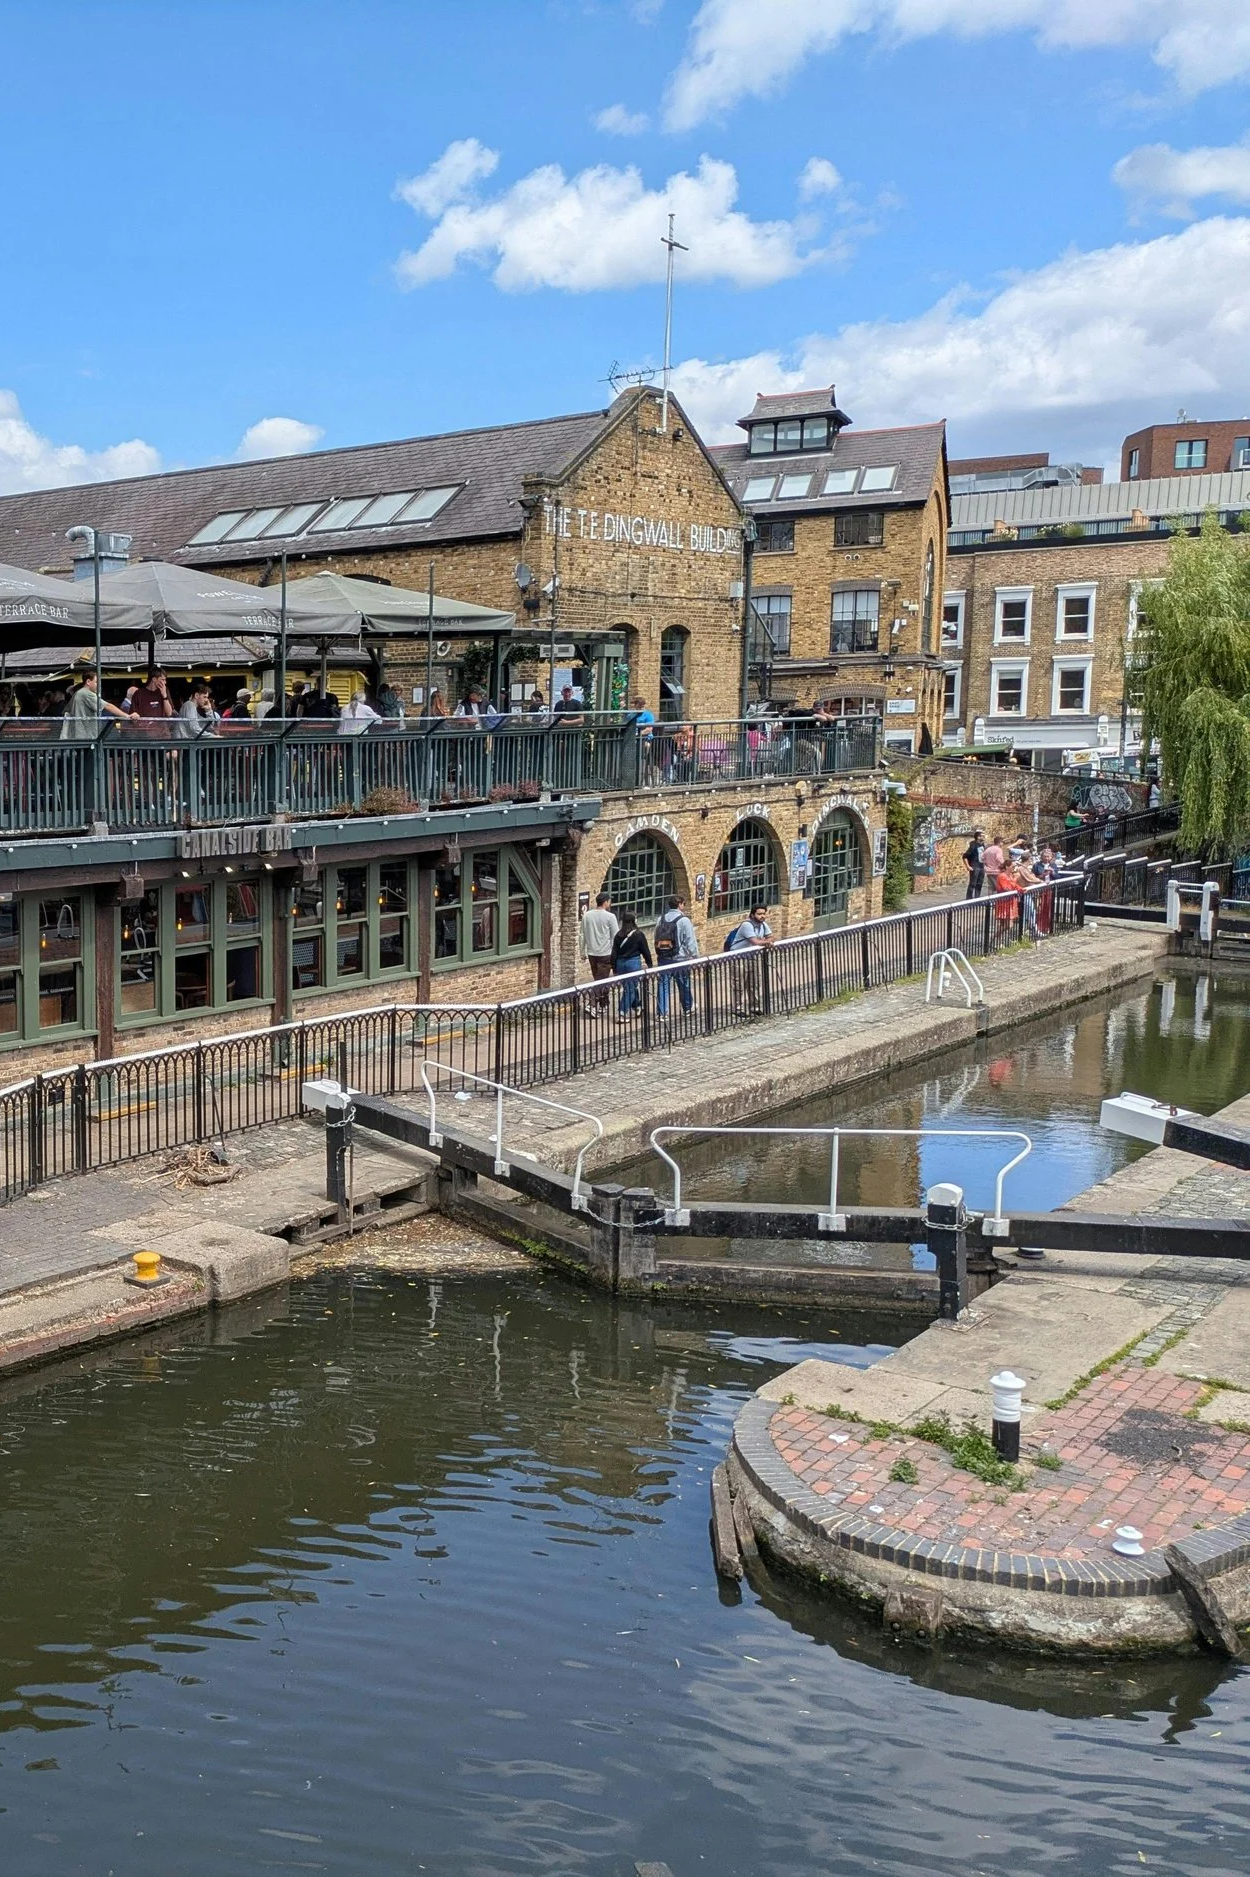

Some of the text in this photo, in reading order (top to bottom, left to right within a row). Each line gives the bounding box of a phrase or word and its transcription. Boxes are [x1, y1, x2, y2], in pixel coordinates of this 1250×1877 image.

[544, 505, 571, 537] THE
[604, 513, 683, 549] DINGWALL
[691, 524, 741, 554] BUILDING
[50, 606, 69, 618] BAR
[241, 616, 276, 627] TERRACE
[614, 815, 680, 847] CAMDEN
[736, 803, 771, 822] LOCK
[181, 828, 291, 858] CANALSIDE BAR
